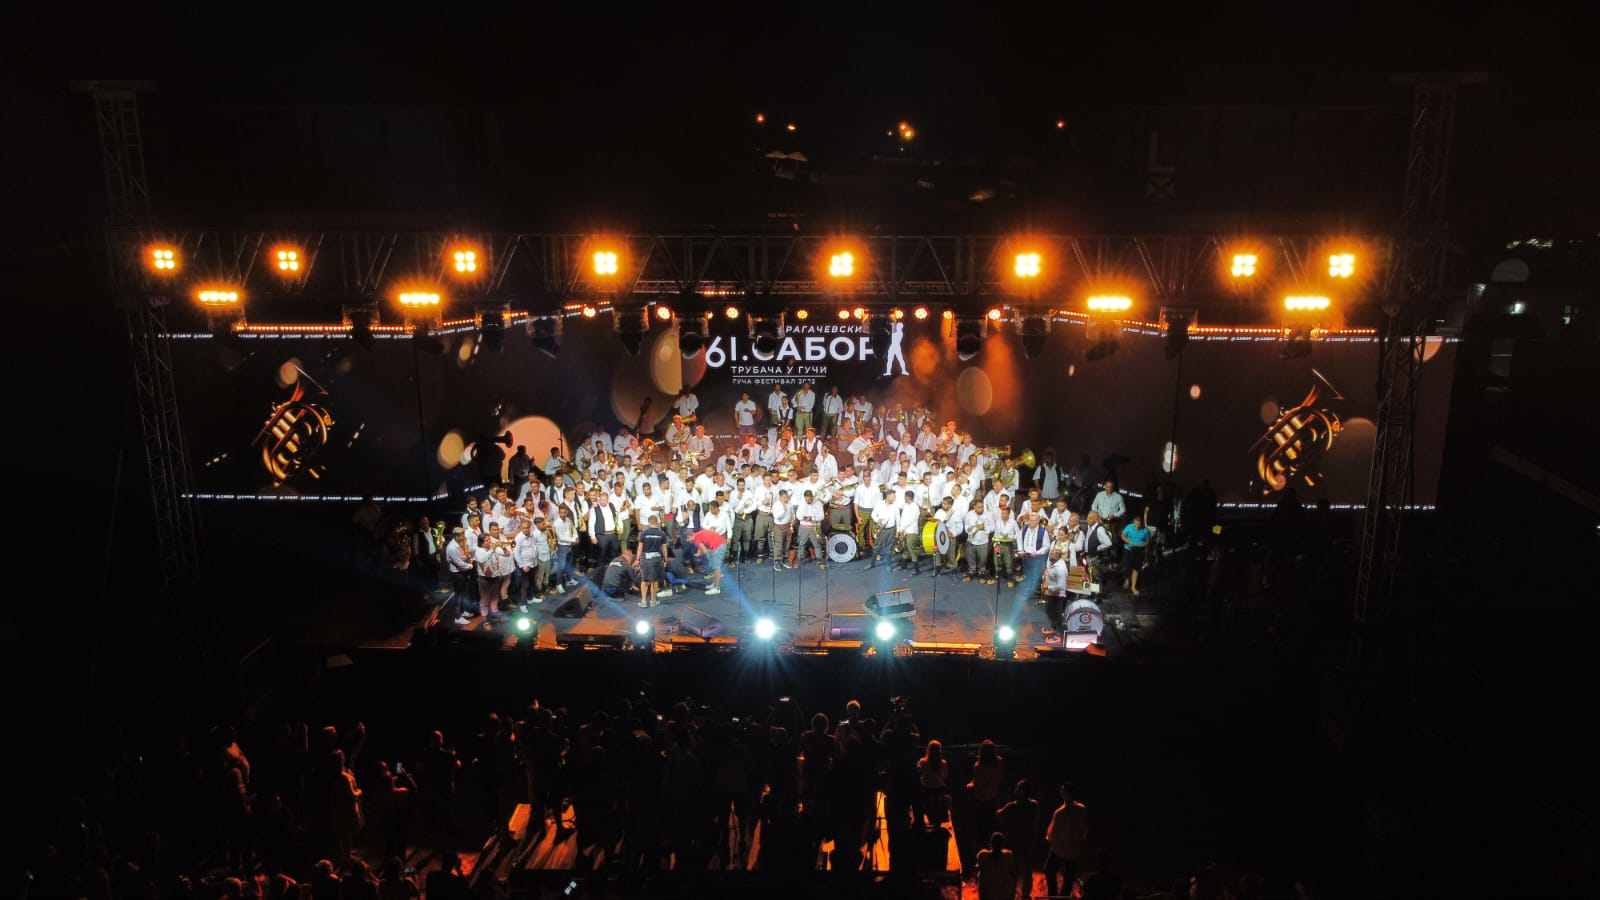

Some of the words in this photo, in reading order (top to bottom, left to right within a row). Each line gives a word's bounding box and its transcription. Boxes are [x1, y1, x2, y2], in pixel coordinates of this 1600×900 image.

[785, 325, 863, 334] РАГАЧЕВСКИ
[731, 366, 782, 374] ТРУБАЧА
[786, 366, 794, 374] У
[798, 366, 827, 374] ГУЧИ
